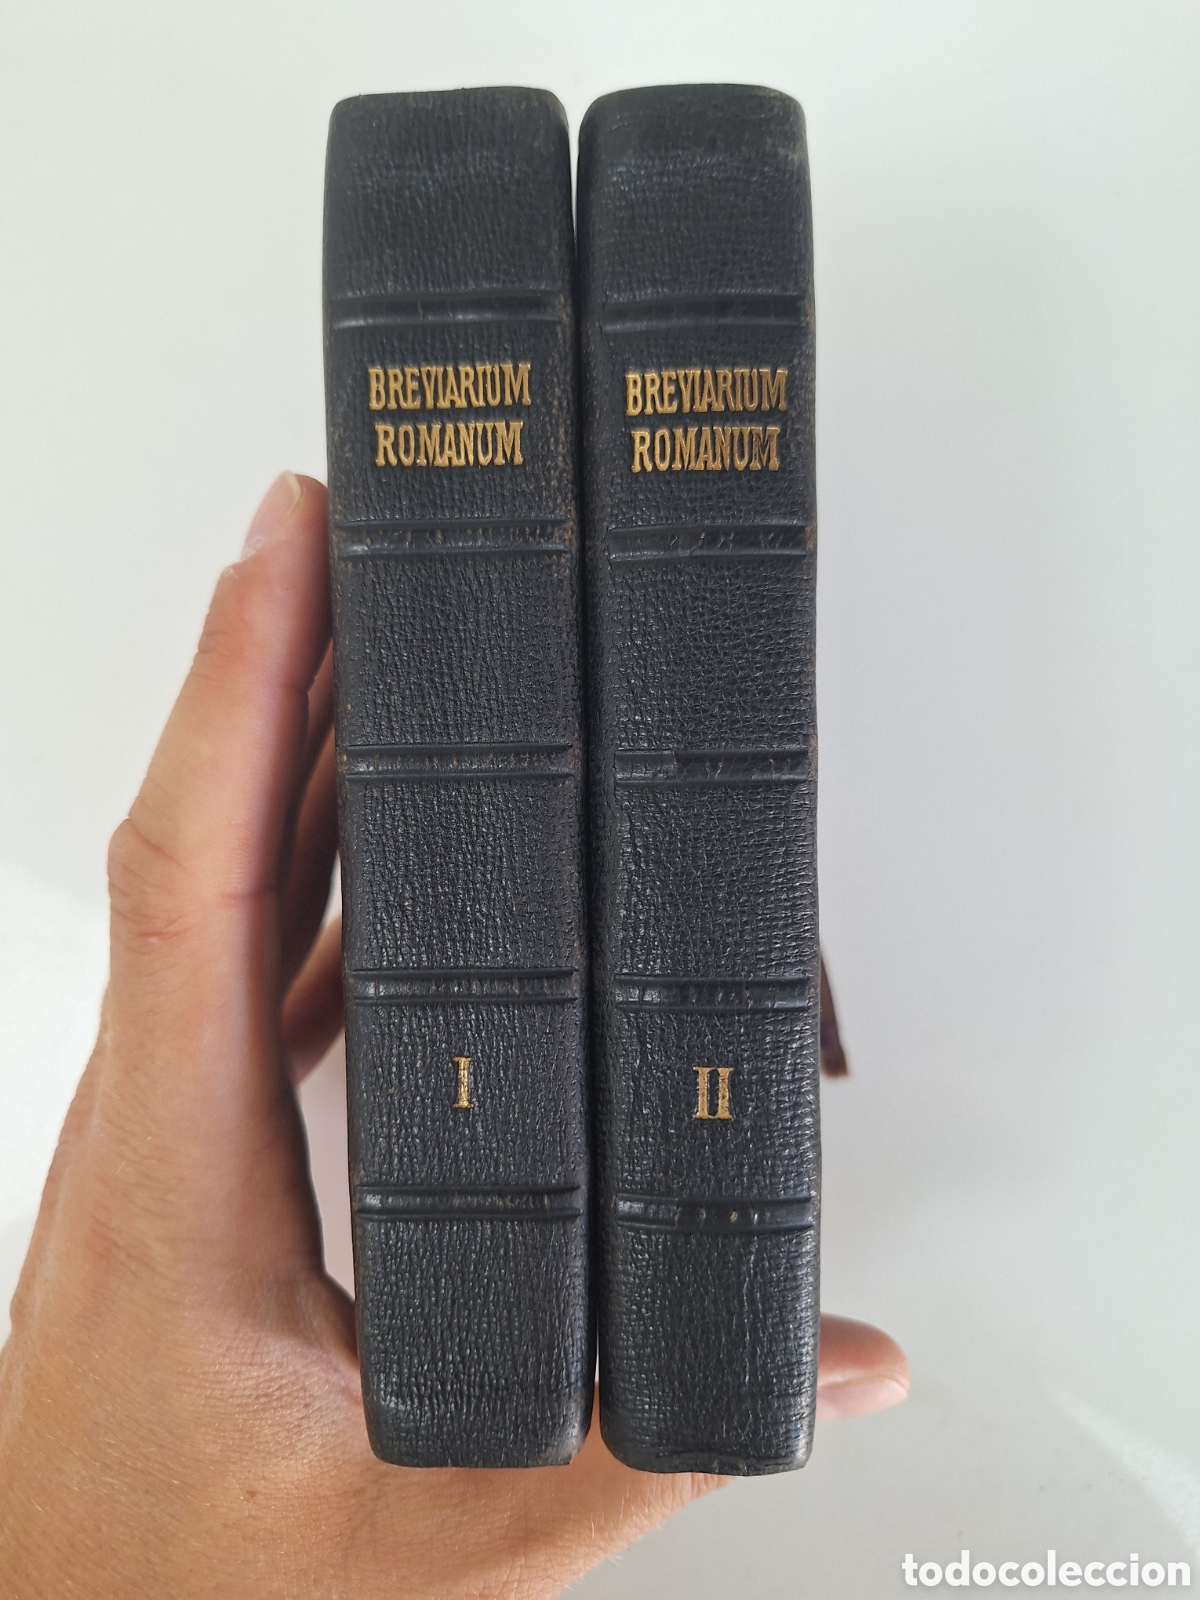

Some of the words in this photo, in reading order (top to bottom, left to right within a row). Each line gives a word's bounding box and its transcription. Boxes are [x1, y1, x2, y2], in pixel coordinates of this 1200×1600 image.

[368, 363, 531, 411] BREVIARIUM
[625, 368, 788, 417] BREVIARIUM
[374, 421, 524, 468] ROMANUM
[631, 426, 780, 473] ROMANUM
[453, 1056, 474, 1109] I
[693, 1067, 734, 1120] II
